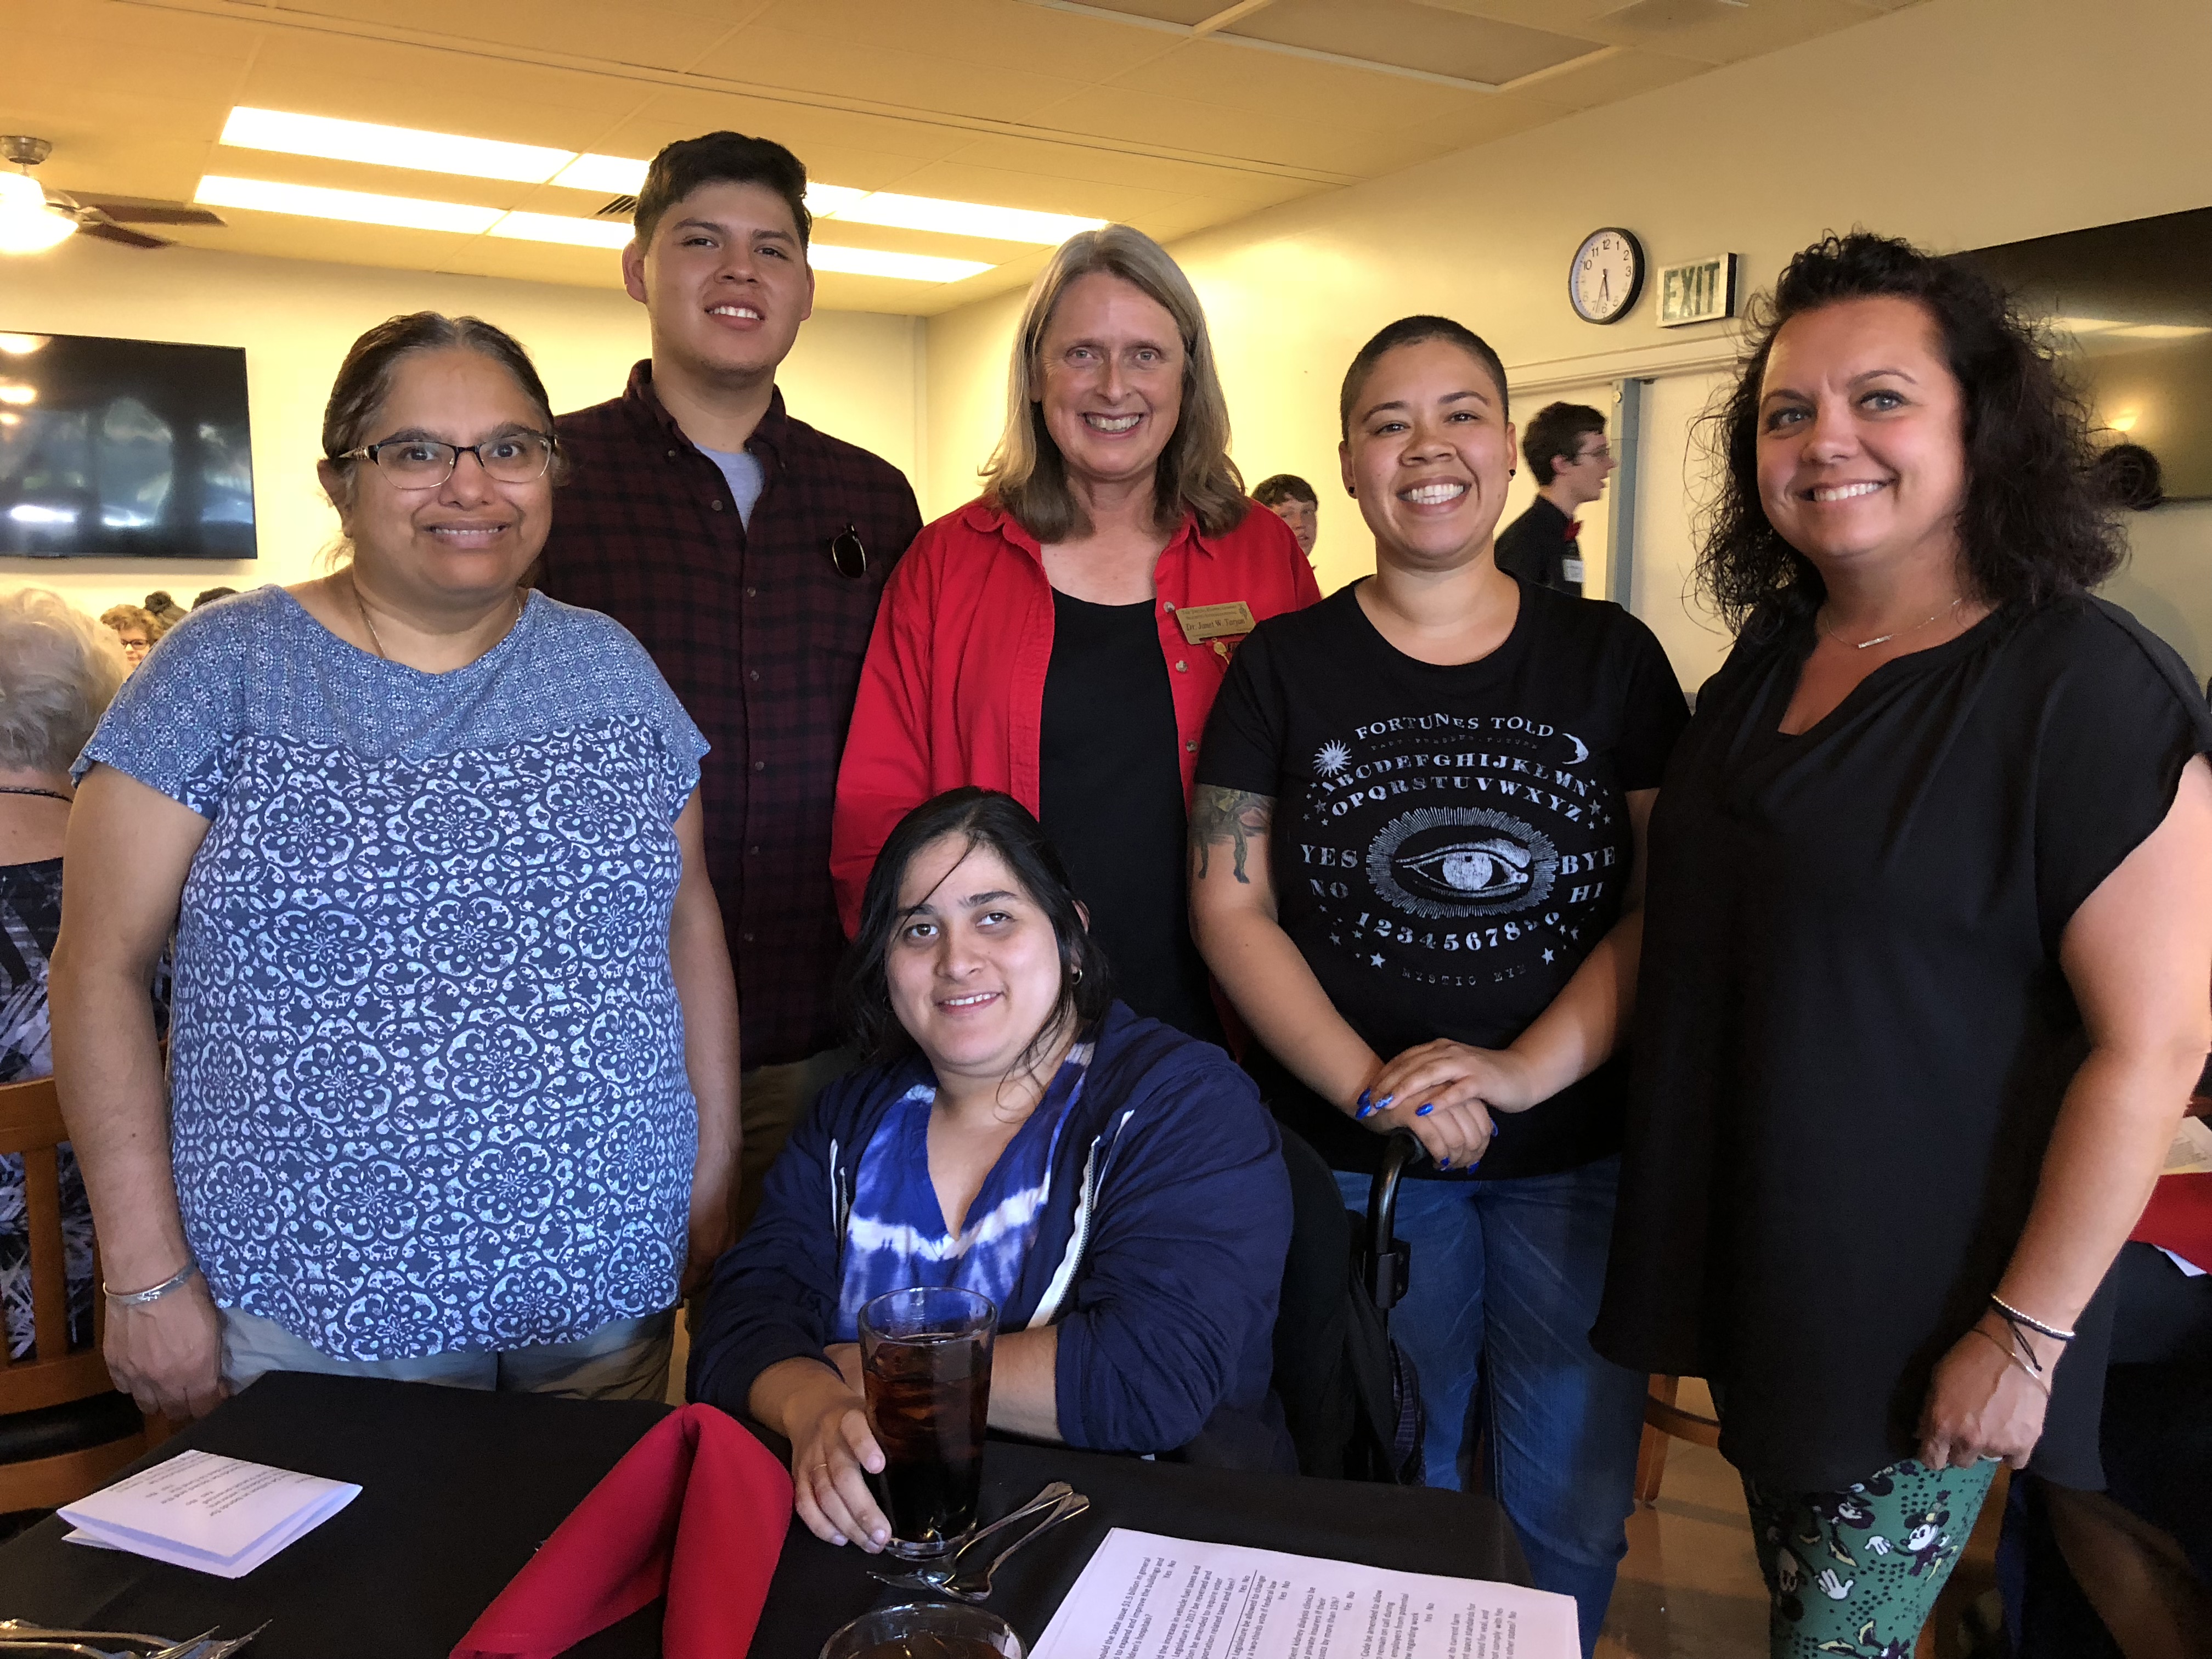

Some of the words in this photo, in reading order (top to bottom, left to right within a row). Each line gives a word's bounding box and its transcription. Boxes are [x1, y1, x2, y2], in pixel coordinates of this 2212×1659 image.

[1602, 239, 1611, 250] 12
[1591, 246, 1599, 257] 11
[1623, 250, 1629, 261] 2
[1583, 259, 1592, 270] 10
[1626, 266, 1632, 277] 3
[1664, 262, 1720, 320] EXIT
[1355, 713, 1479, 740] FORTUNES
[1491, 716, 1554, 736] TOLD
[1300, 844, 1358, 868] YES
[1560, 846, 1615, 875] BYE
[1310, 879, 1349, 899] NO
[1567, 881, 1604, 903] HI
[1163, 1570, 1172, 1578] Yes
[1238, 1584, 1248, 1593] Yes
[1281, 1580, 1290, 1588] No
[1278, 1591, 1287, 1600] Yes
[1346, 1590, 1355, 1599] No
[1343, 1602, 1352, 1610] Yes
